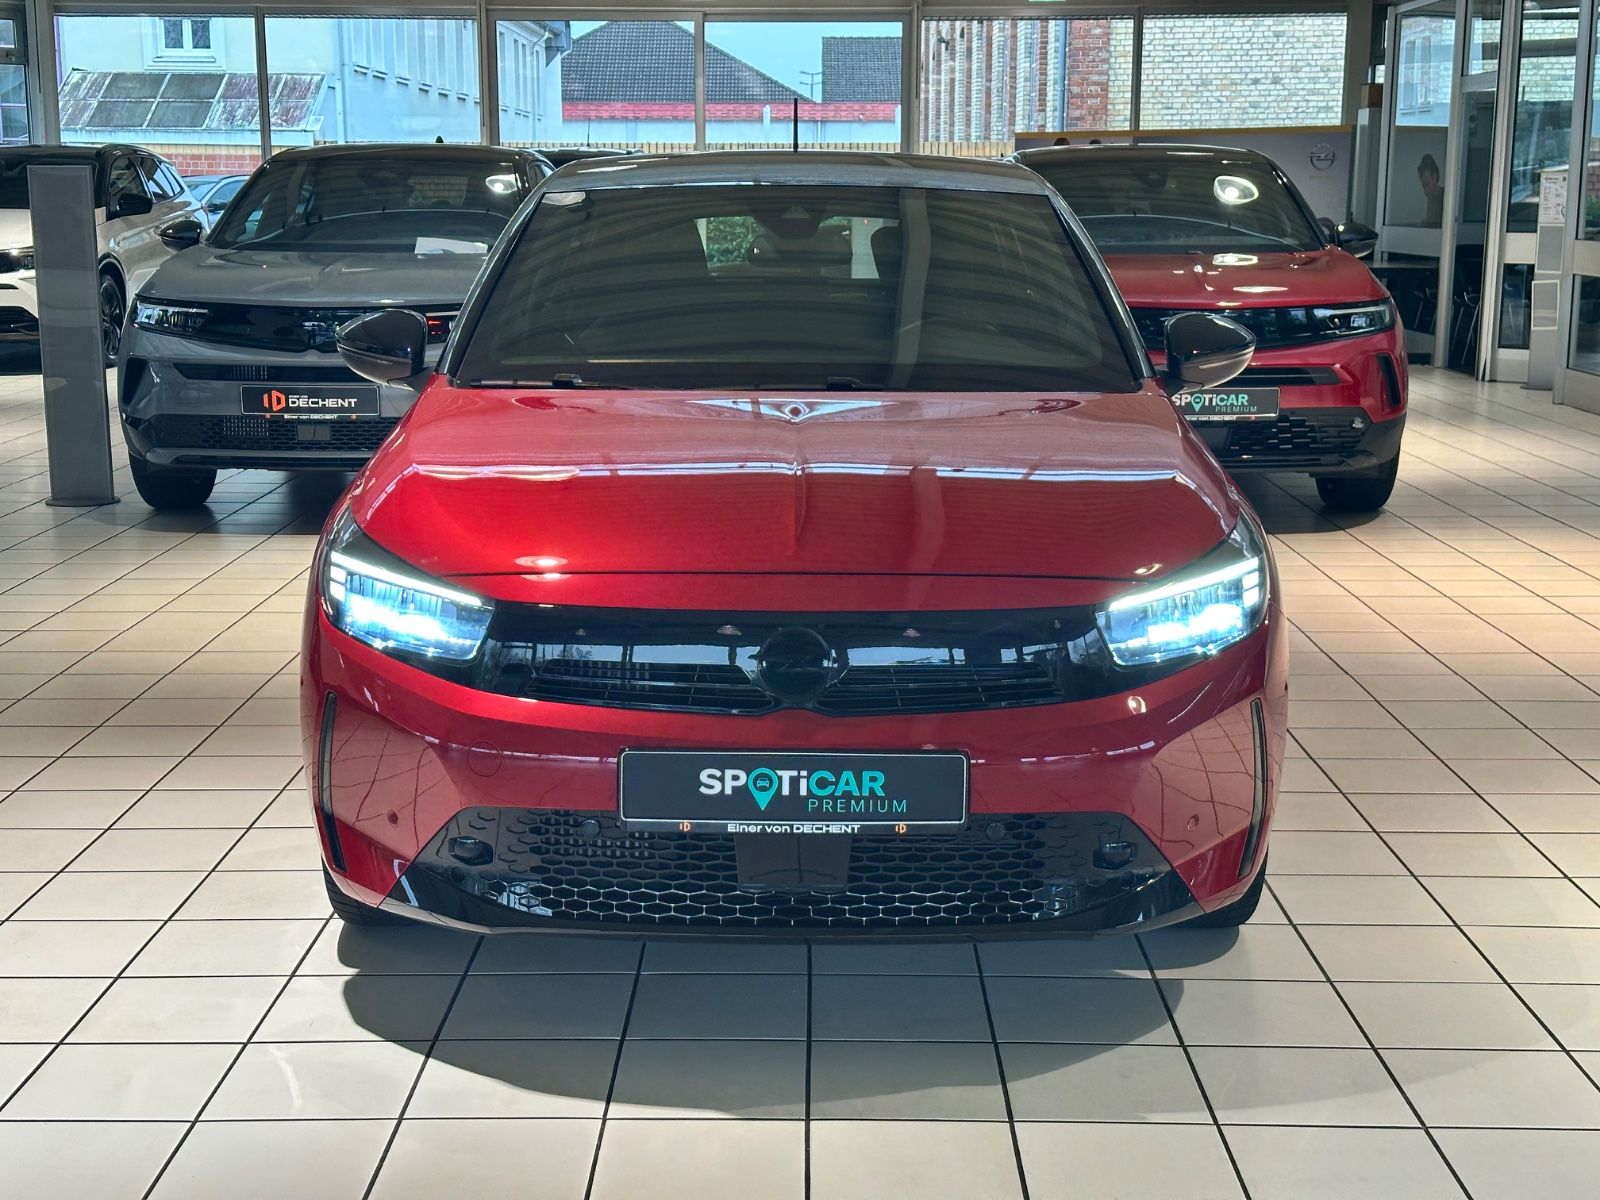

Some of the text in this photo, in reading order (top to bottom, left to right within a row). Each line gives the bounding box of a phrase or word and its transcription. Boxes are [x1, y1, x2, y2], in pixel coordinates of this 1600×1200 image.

[288, 398, 358, 408] DECHENT
[808, 799, 908, 813] PREMIUM
[727, 823, 861, 834] Einer von DECHENT
